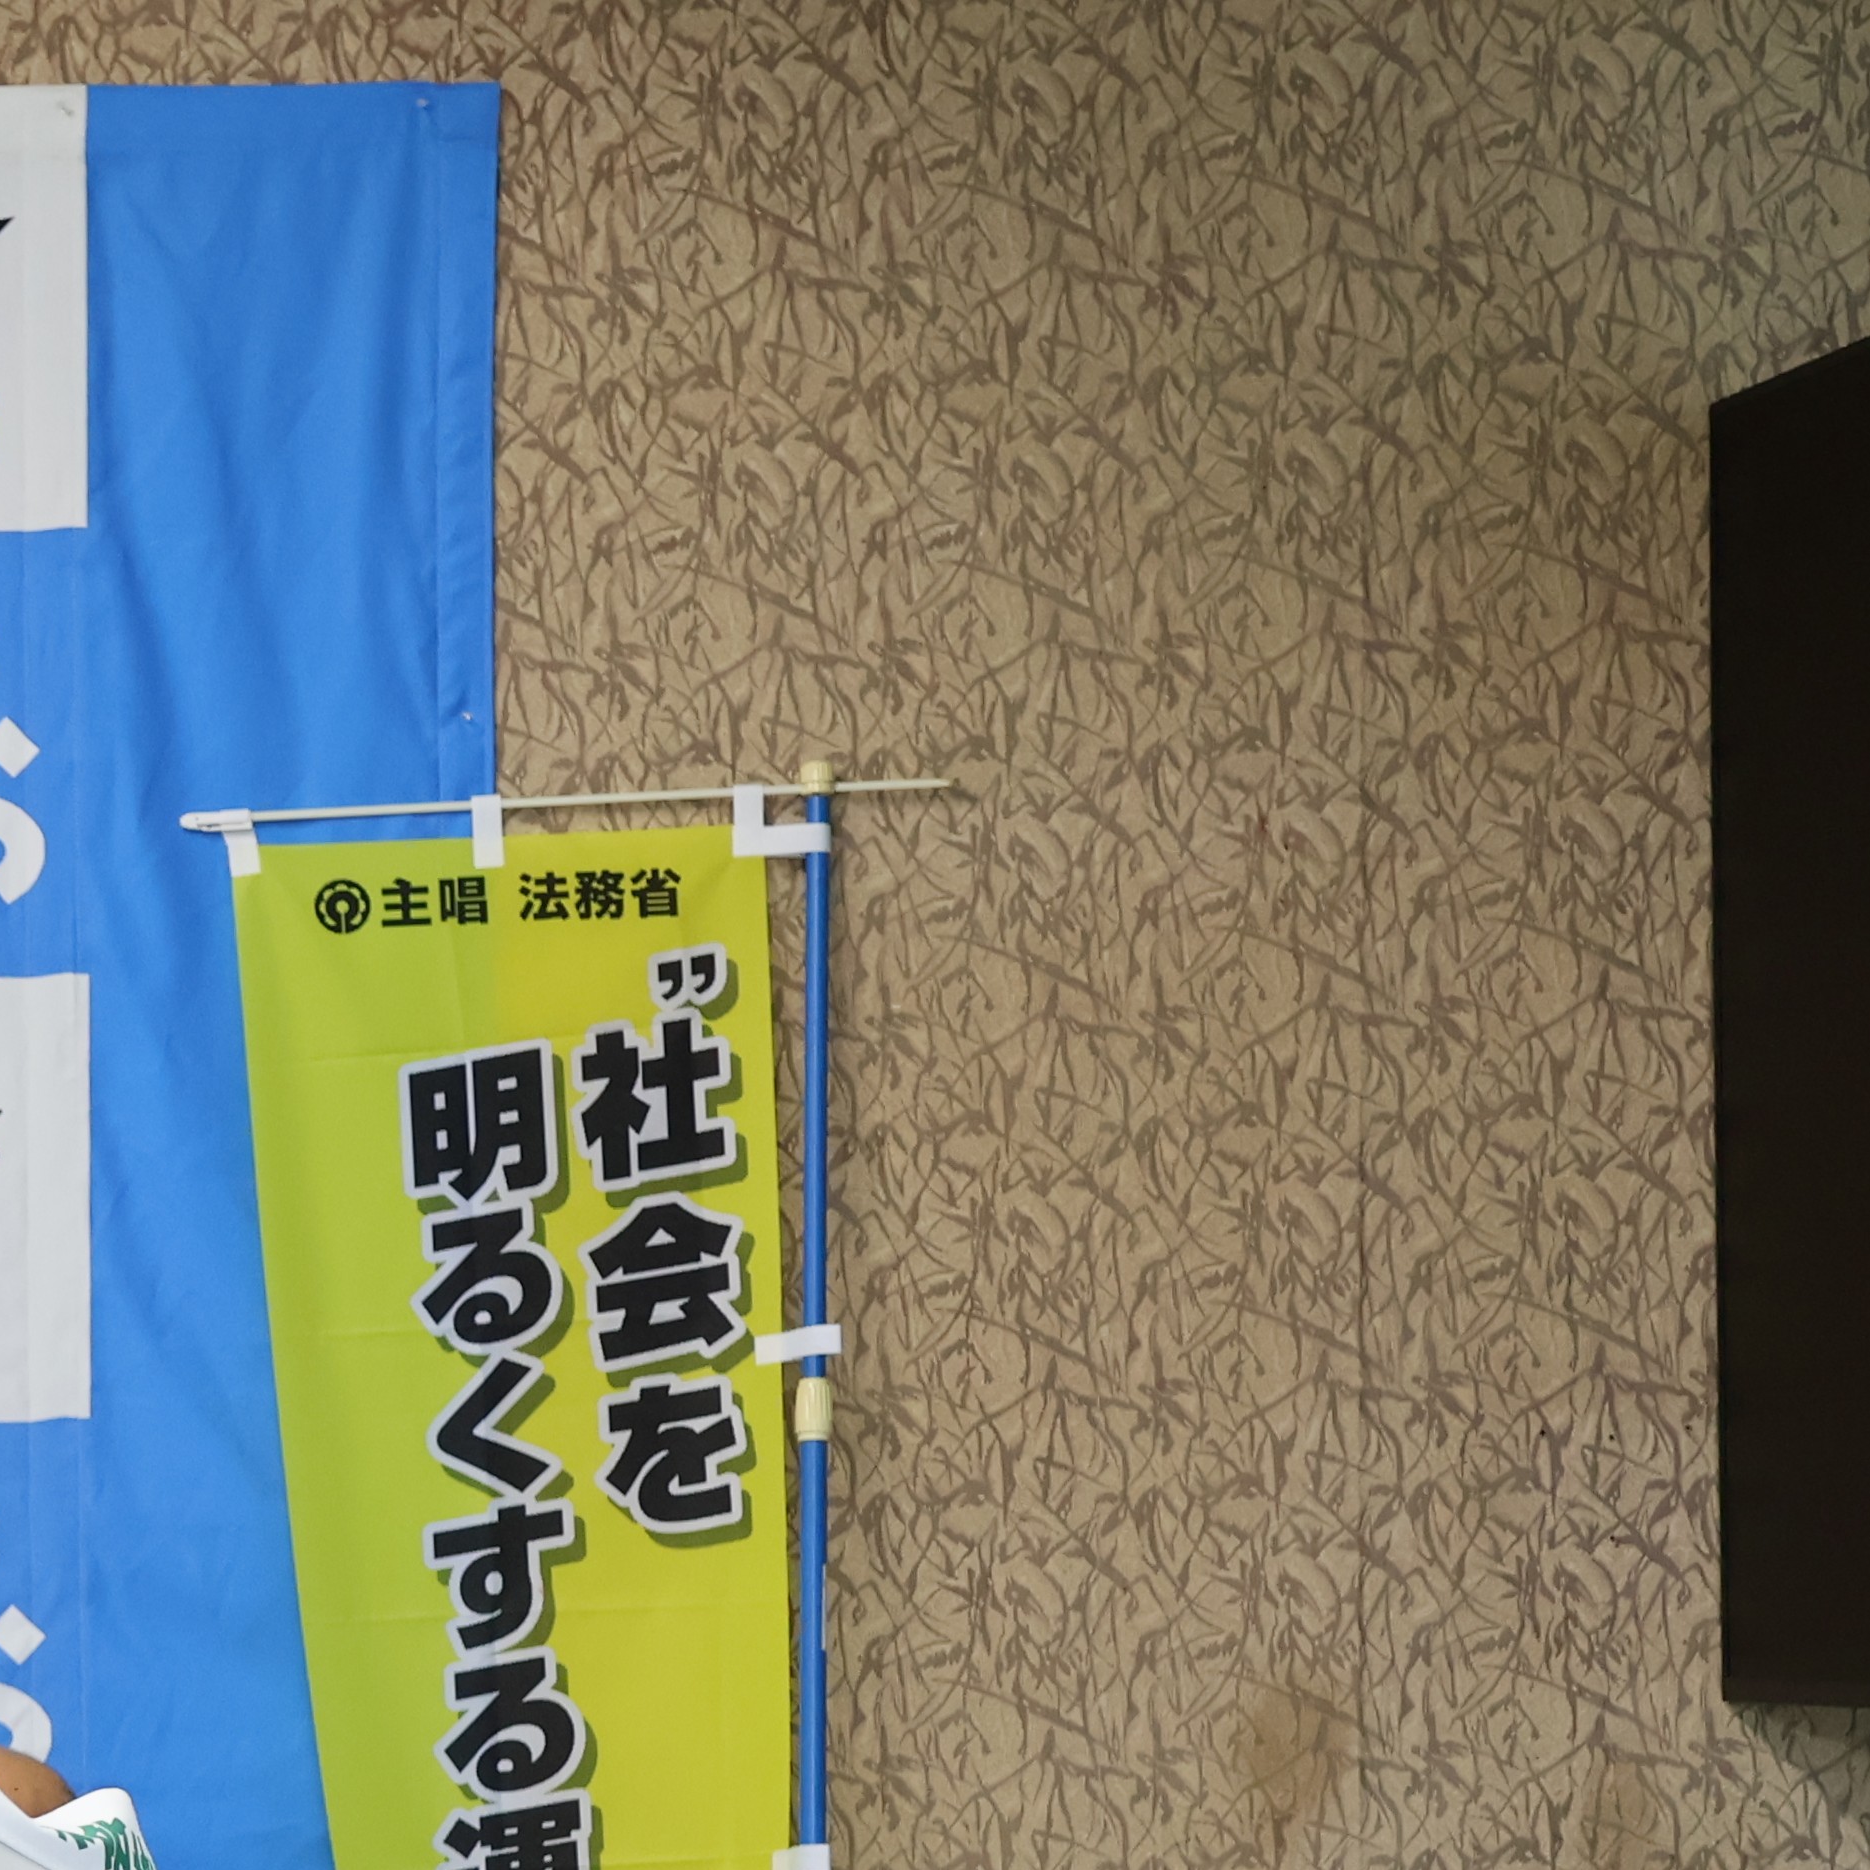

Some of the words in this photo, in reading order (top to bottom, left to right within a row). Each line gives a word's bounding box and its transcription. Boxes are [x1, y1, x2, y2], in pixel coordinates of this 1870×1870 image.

[381, 875, 490, 928] 主唱
[517, 868, 682, 922] 法務省
